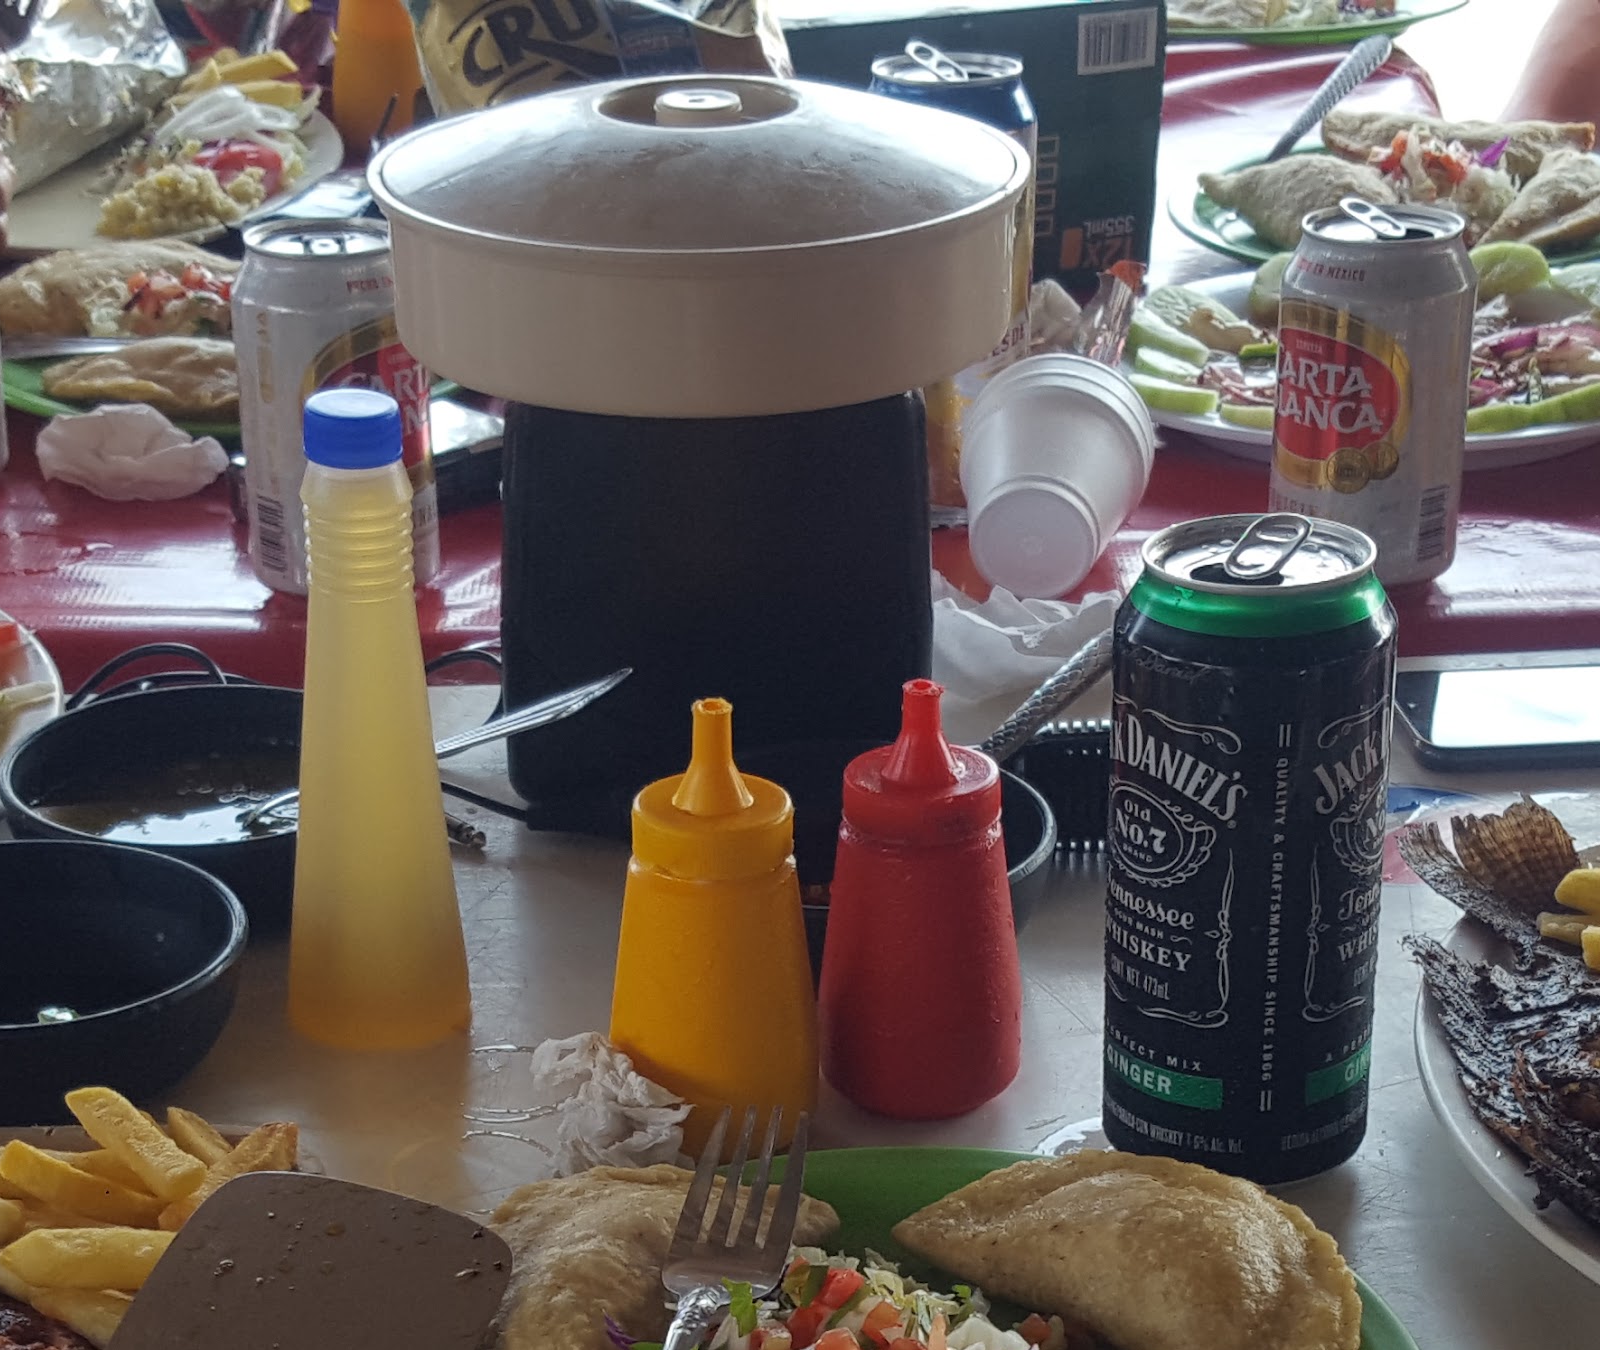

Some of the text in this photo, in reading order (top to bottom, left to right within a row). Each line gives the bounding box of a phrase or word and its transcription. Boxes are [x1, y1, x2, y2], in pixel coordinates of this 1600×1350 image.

[1280, 350, 1373, 398] ARTA
[1127, 713, 1249, 821] DANIEL'S
[1274, 757, 1289, 825] QUALITY
[1312, 730, 1380, 815] JACK
[1272, 833, 1285, 844] &
[1265, 851, 1284, 984] CRAFTSMANSHIP
[1263, 990, 1277, 1036] SINCE
[1106, 1018, 1202, 1072] ERFECT MIX
